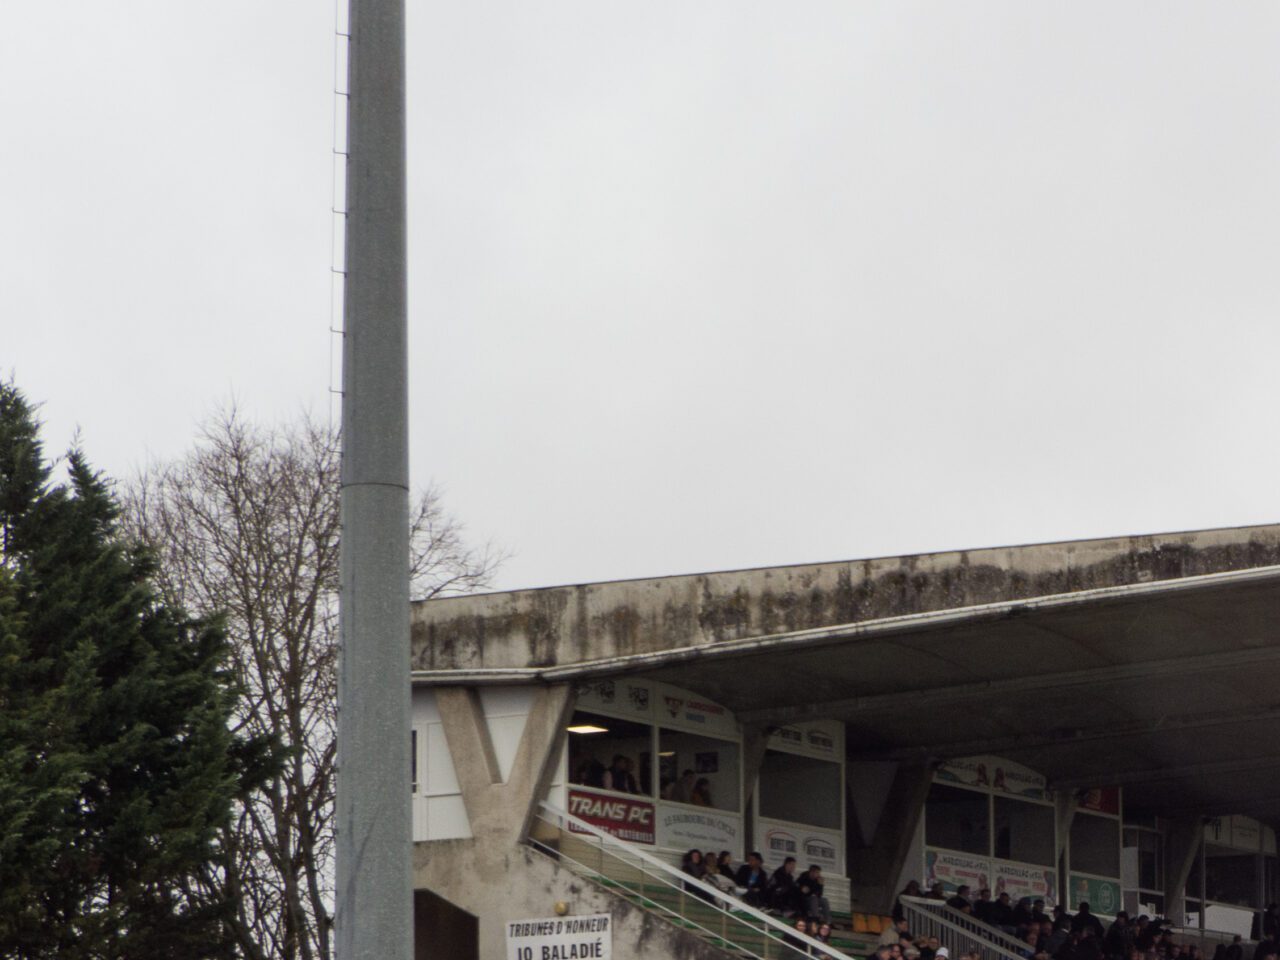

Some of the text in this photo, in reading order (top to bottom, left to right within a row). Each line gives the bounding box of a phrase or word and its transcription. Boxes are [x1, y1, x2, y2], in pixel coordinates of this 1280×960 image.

[570, 795, 653, 826] TRANS PC
[509, 917, 609, 937] TRIBUNES D'HONNEUR
